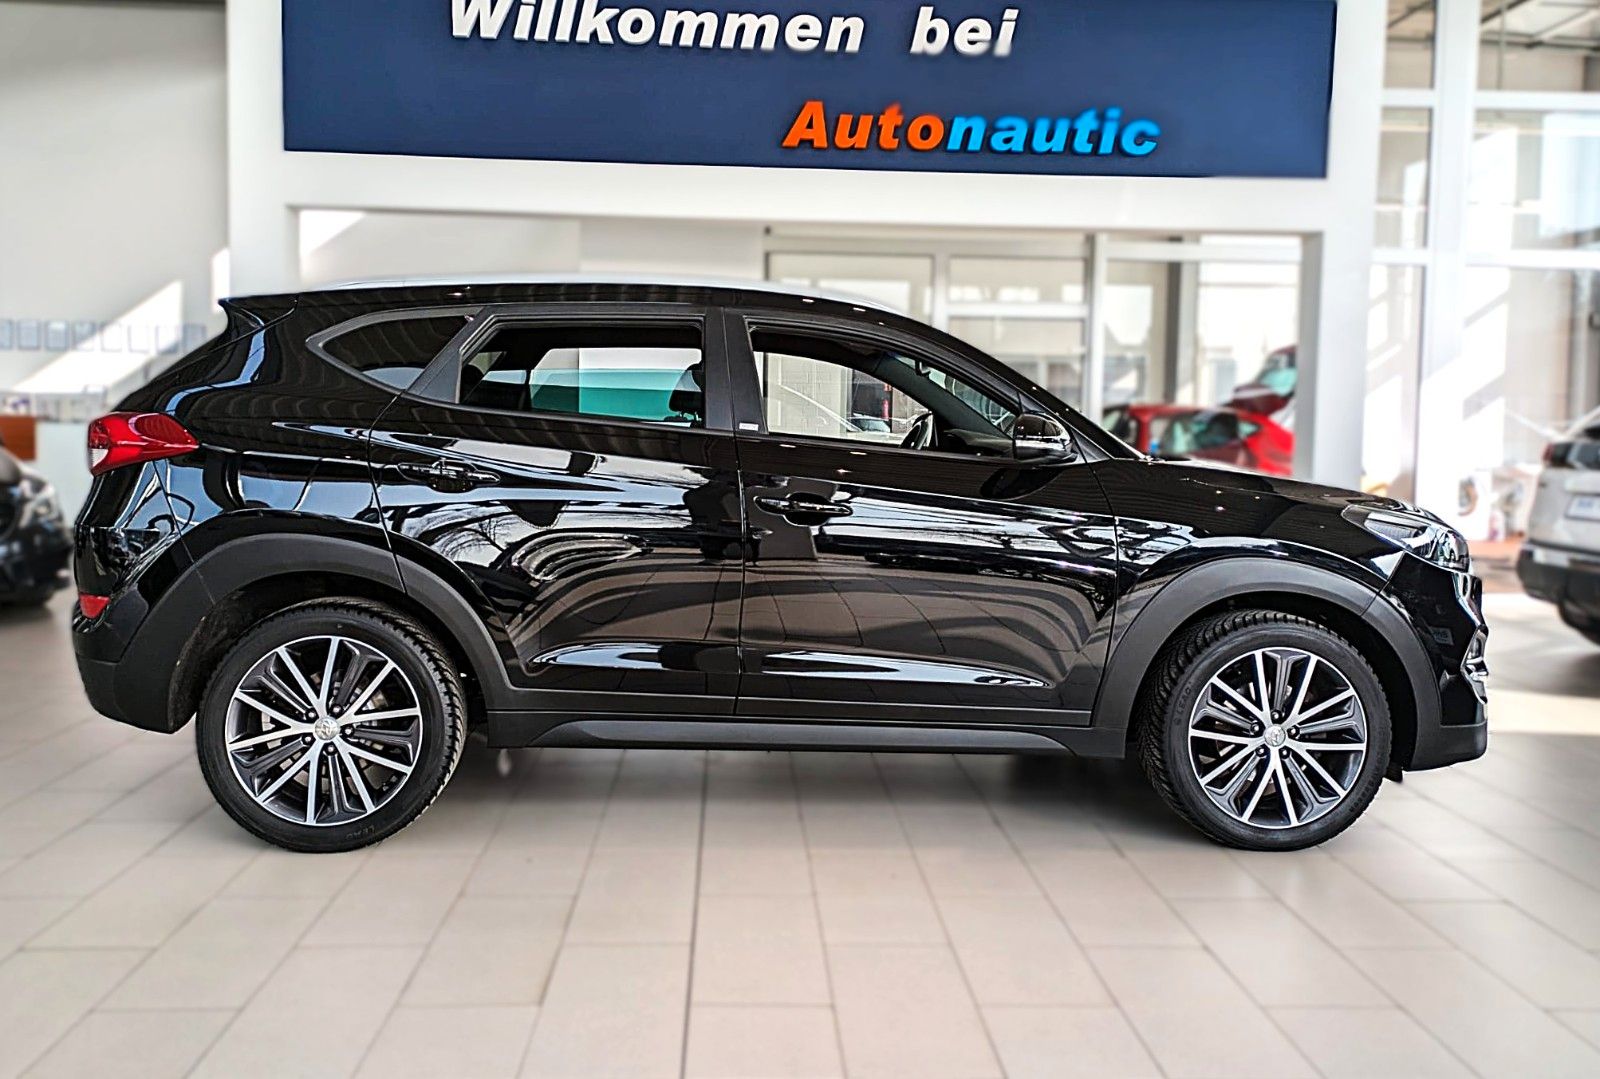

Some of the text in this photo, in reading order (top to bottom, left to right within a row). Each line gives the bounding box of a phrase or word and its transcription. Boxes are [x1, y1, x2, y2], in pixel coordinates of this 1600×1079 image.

[450, 0, 1019, 57] Willkommen bei
[781, 100, 1161, 156] Autonautic
